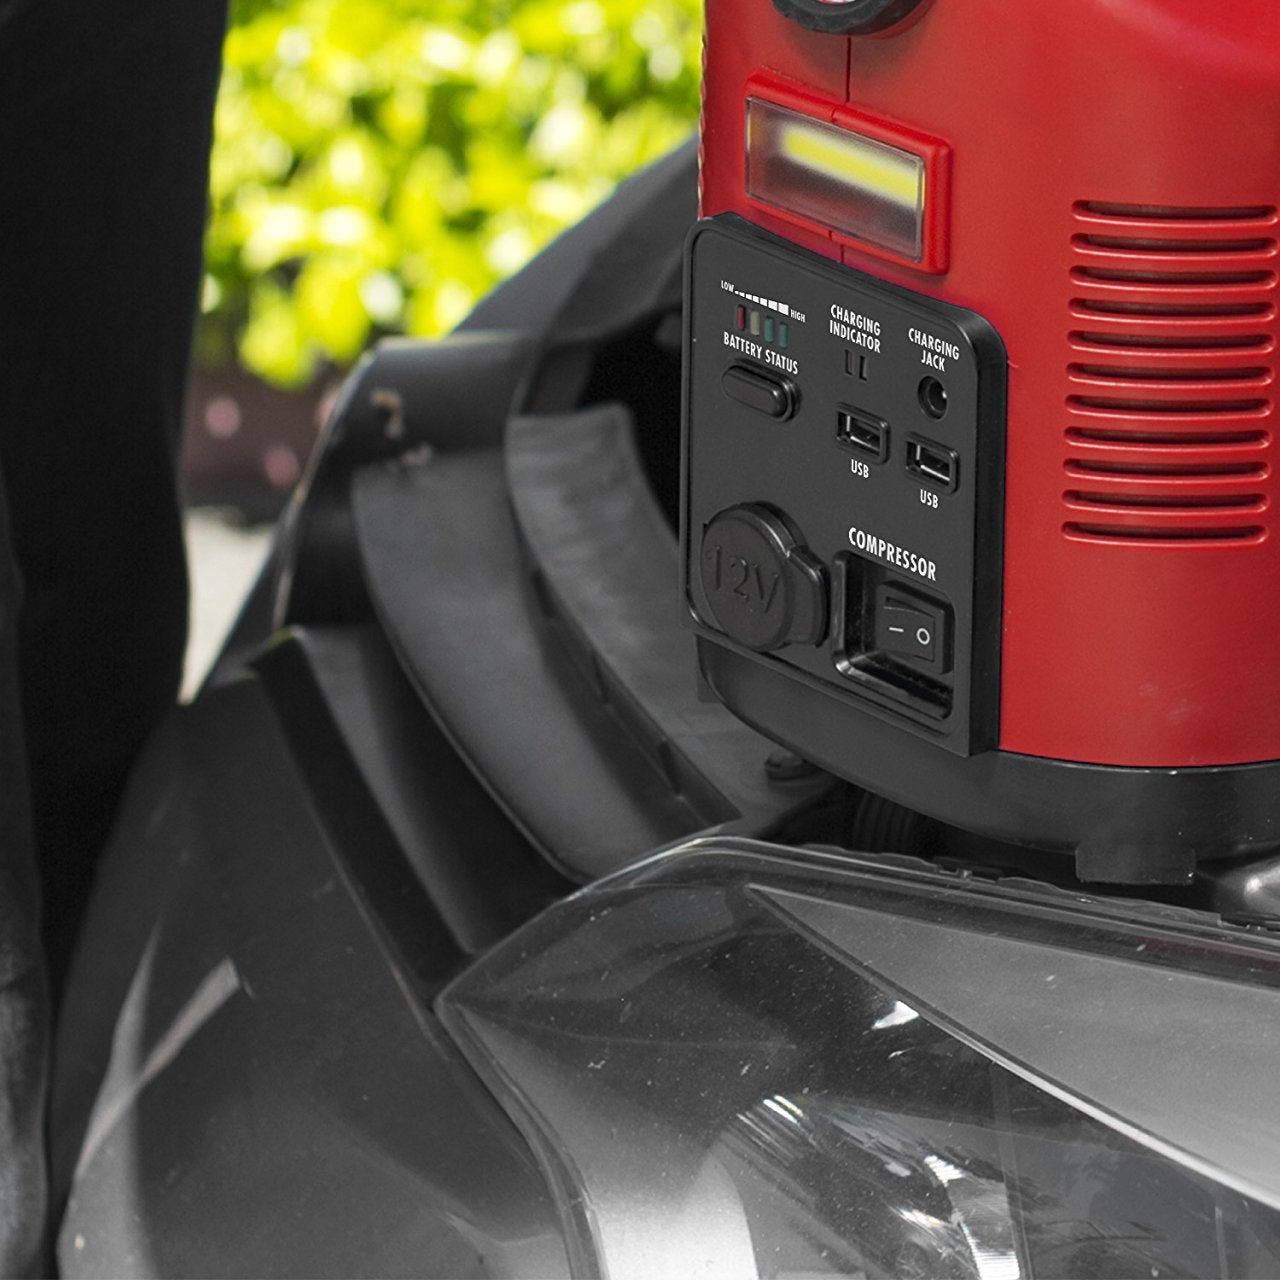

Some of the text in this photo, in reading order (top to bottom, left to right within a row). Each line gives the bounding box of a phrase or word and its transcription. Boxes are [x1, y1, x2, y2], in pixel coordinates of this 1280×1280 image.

[720, 280, 735, 293] LOW
[790, 308, 806, 323] HIGH
[830, 303, 881, 337] CHARGING
[723, 331, 799, 375] BATTERY STATUS
[829, 319, 881, 354] INDICATOR
[908, 327, 960, 361] CHARGING
[921, 349, 946, 372] JACK
[851, 458, 870, 479] USB
[919, 488, 939, 509] USB
[848, 526, 937, 582] COMPRESSOR
[705, 544, 780, 615] 12V
